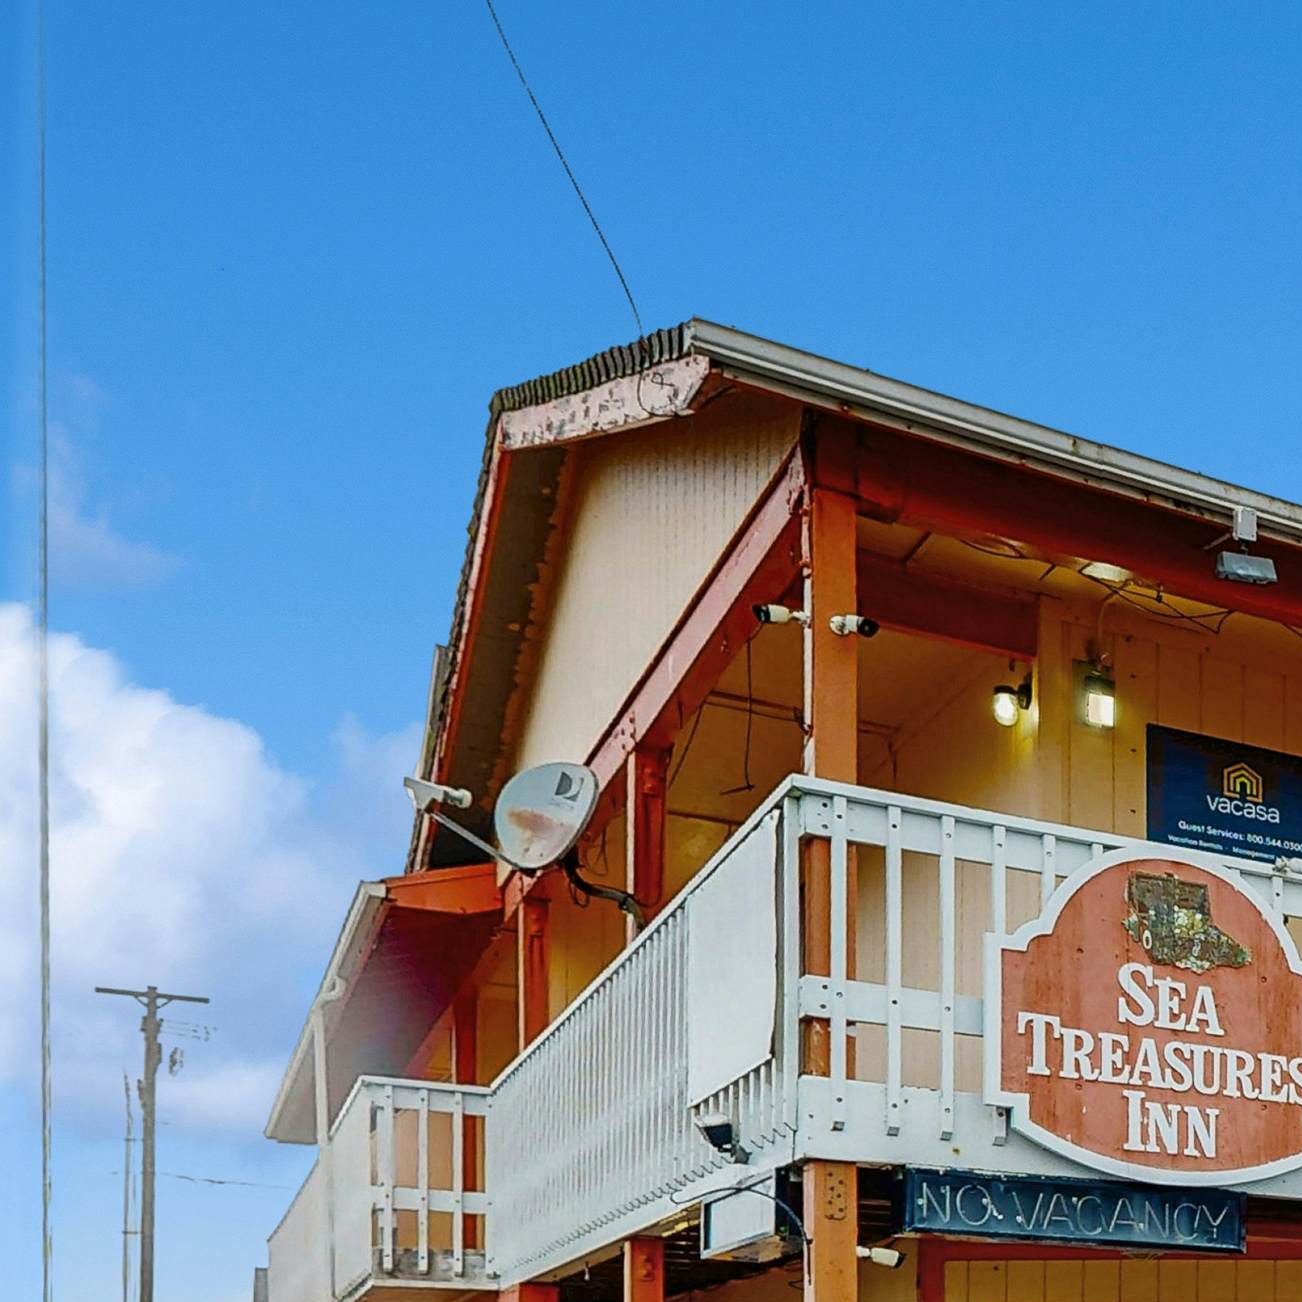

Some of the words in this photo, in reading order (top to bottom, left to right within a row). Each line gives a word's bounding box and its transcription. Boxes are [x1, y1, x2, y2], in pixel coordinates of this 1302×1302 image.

[1178, 820, 1205, 833] Guest
[1206, 825, 1245, 840] Services:
[1206, 794, 1280, 824] vacasa
[1118, 962, 1225, 1037] SEA
[1122, 1089, 1220, 1159] INN
[919, 1181, 992, 1226] NO
[1012, 1190, 1229, 1241] VACANCY
